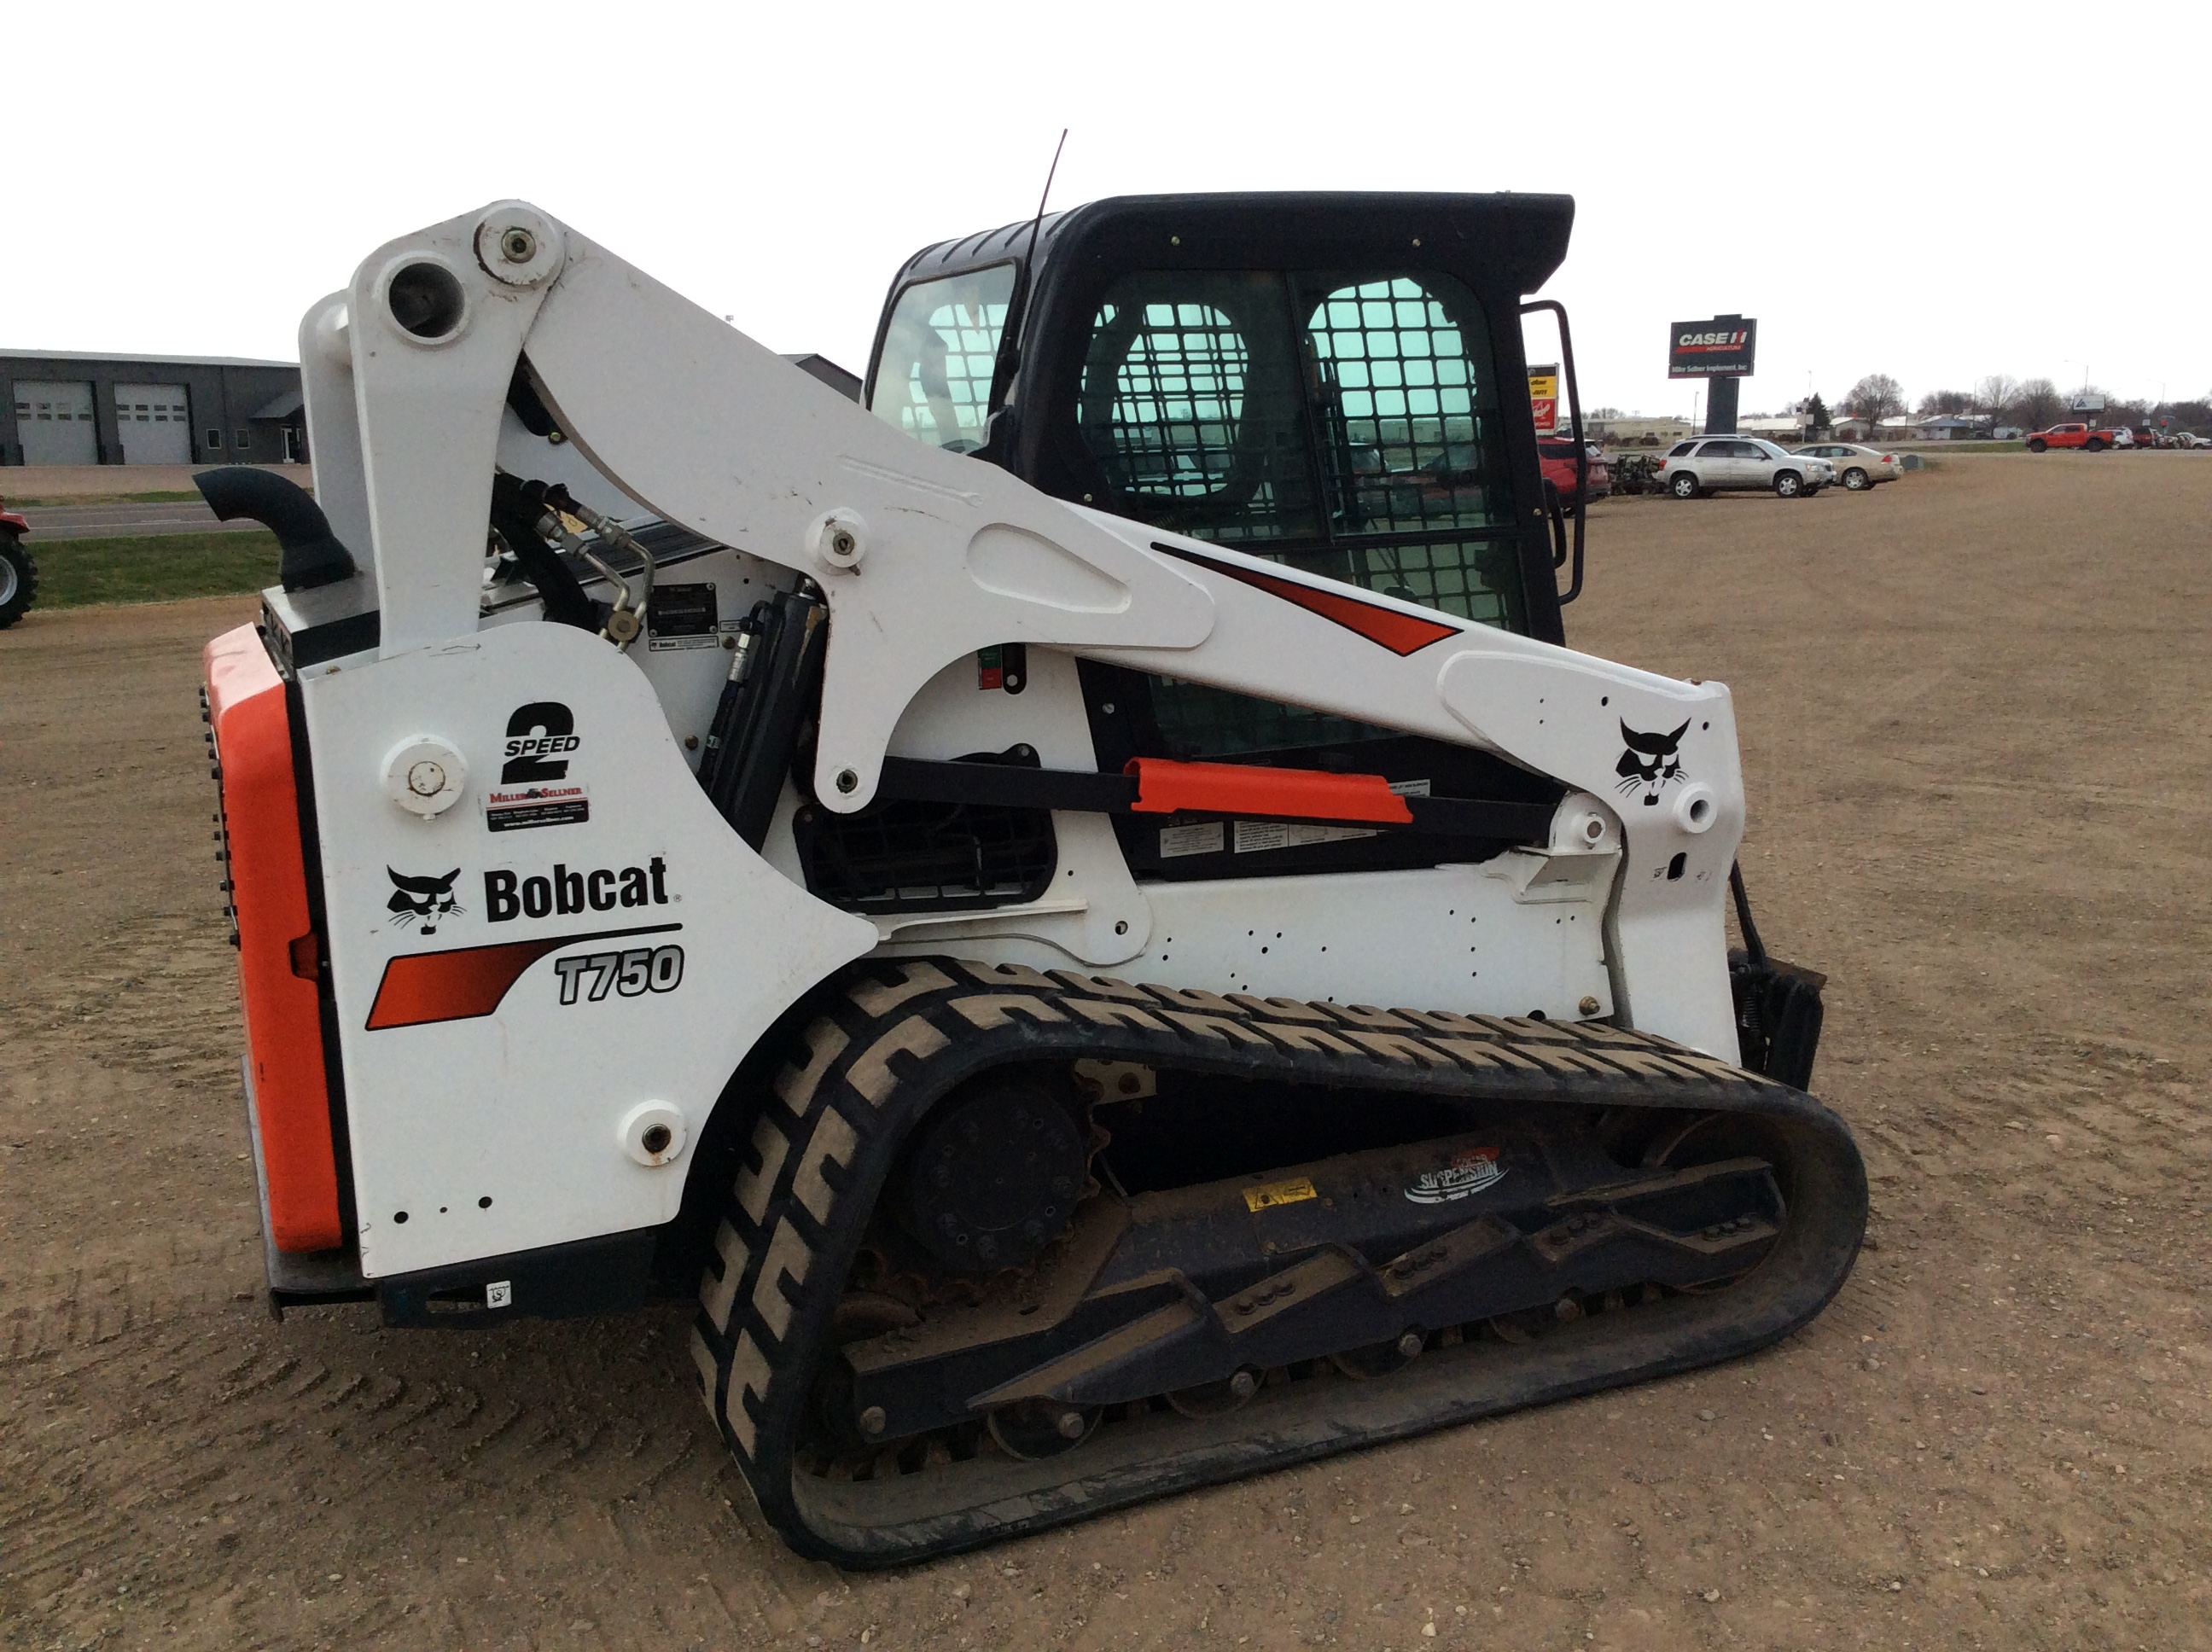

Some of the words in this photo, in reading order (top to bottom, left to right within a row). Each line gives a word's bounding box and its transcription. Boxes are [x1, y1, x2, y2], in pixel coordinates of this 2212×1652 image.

[1679, 332, 1729, 346] CASE
[500, 701, 574, 785] 2
[504, 736, 581, 758] SPEED
[484, 856, 669, 923] Bobcat
[555, 944, 685, 1006] T750
